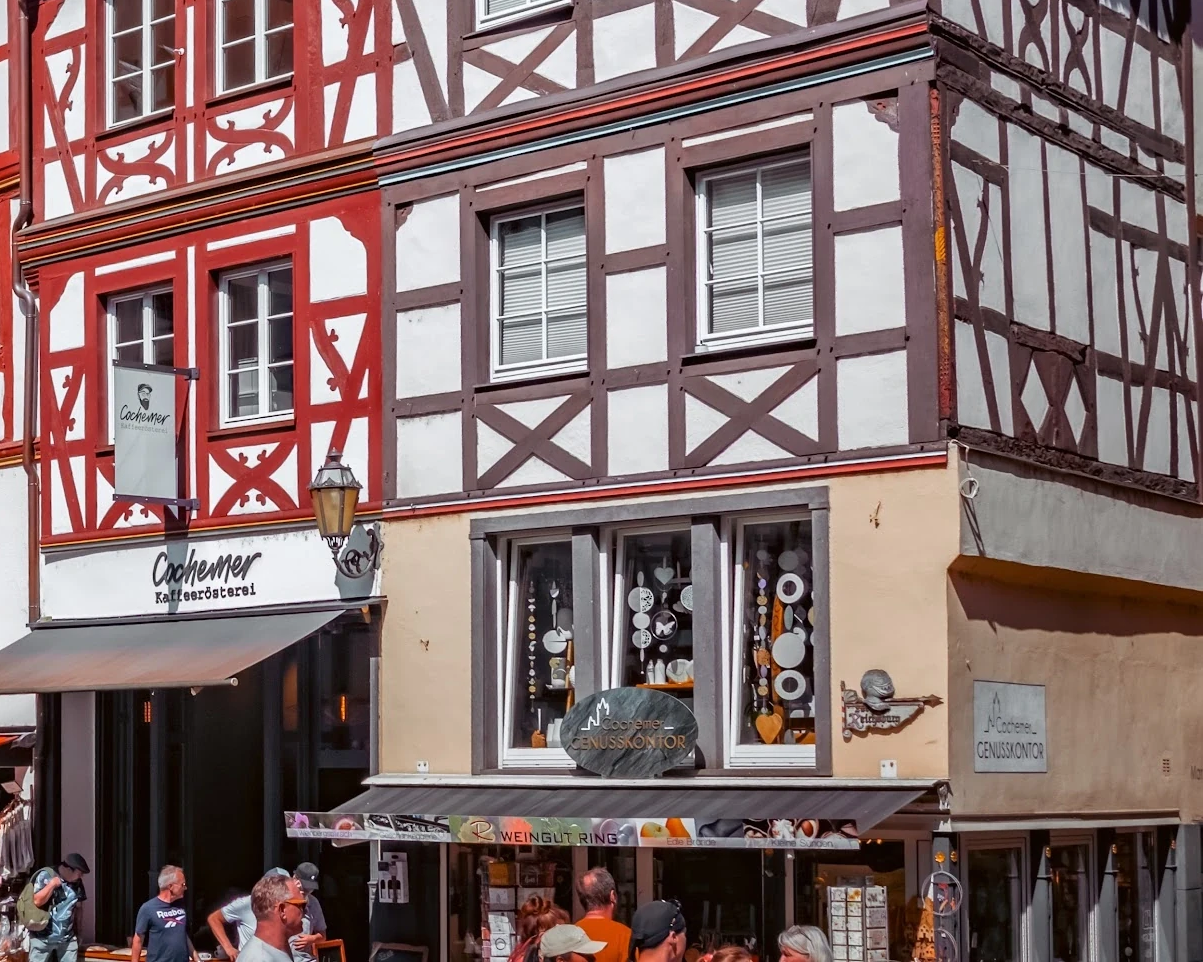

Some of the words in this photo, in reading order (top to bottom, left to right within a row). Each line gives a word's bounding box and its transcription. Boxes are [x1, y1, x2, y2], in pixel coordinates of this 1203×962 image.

[120, 404, 170, 426] Cochemer
[152, 548, 262, 587] Cochemer
[155, 583, 256, 604] Kaffeerösterei
[601, 718, 665, 731] Cochemer
[996, 716, 1032, 734] Cochemer
[570, 735, 686, 751] GENUSSKONTOR
[977, 741, 1044, 759] GENUSSKONTOR
[500, 831, 573, 844] WEINGUT
[579, 833, 618, 845] RING
